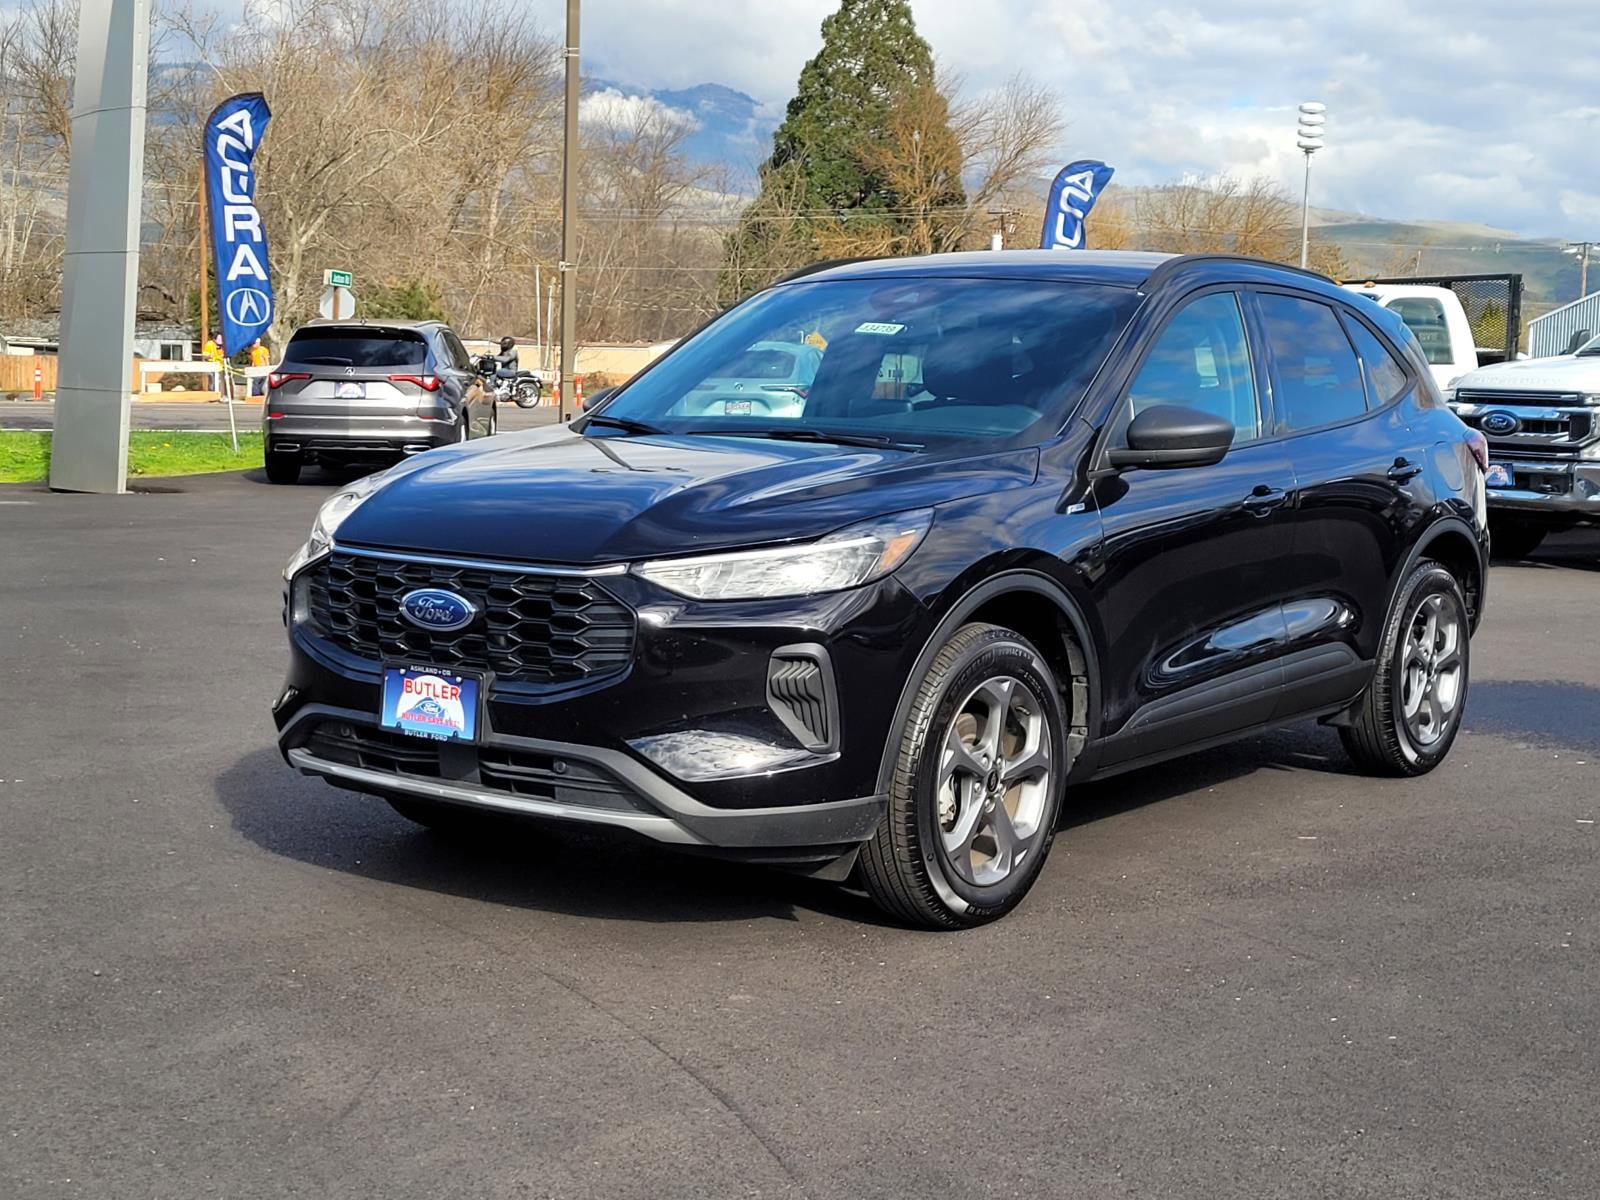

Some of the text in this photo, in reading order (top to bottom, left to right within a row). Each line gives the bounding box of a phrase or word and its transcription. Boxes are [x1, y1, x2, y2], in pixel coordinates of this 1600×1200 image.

[216, 108, 268, 281] ACURA
[1052, 170, 1094, 250] ACU
[414, 596, 454, 622] Ford
[410, 665, 438, 675] ASHLAND
[403, 678, 461, 701] BUTLER
[404, 729, 448, 742] BUTLER FORD
